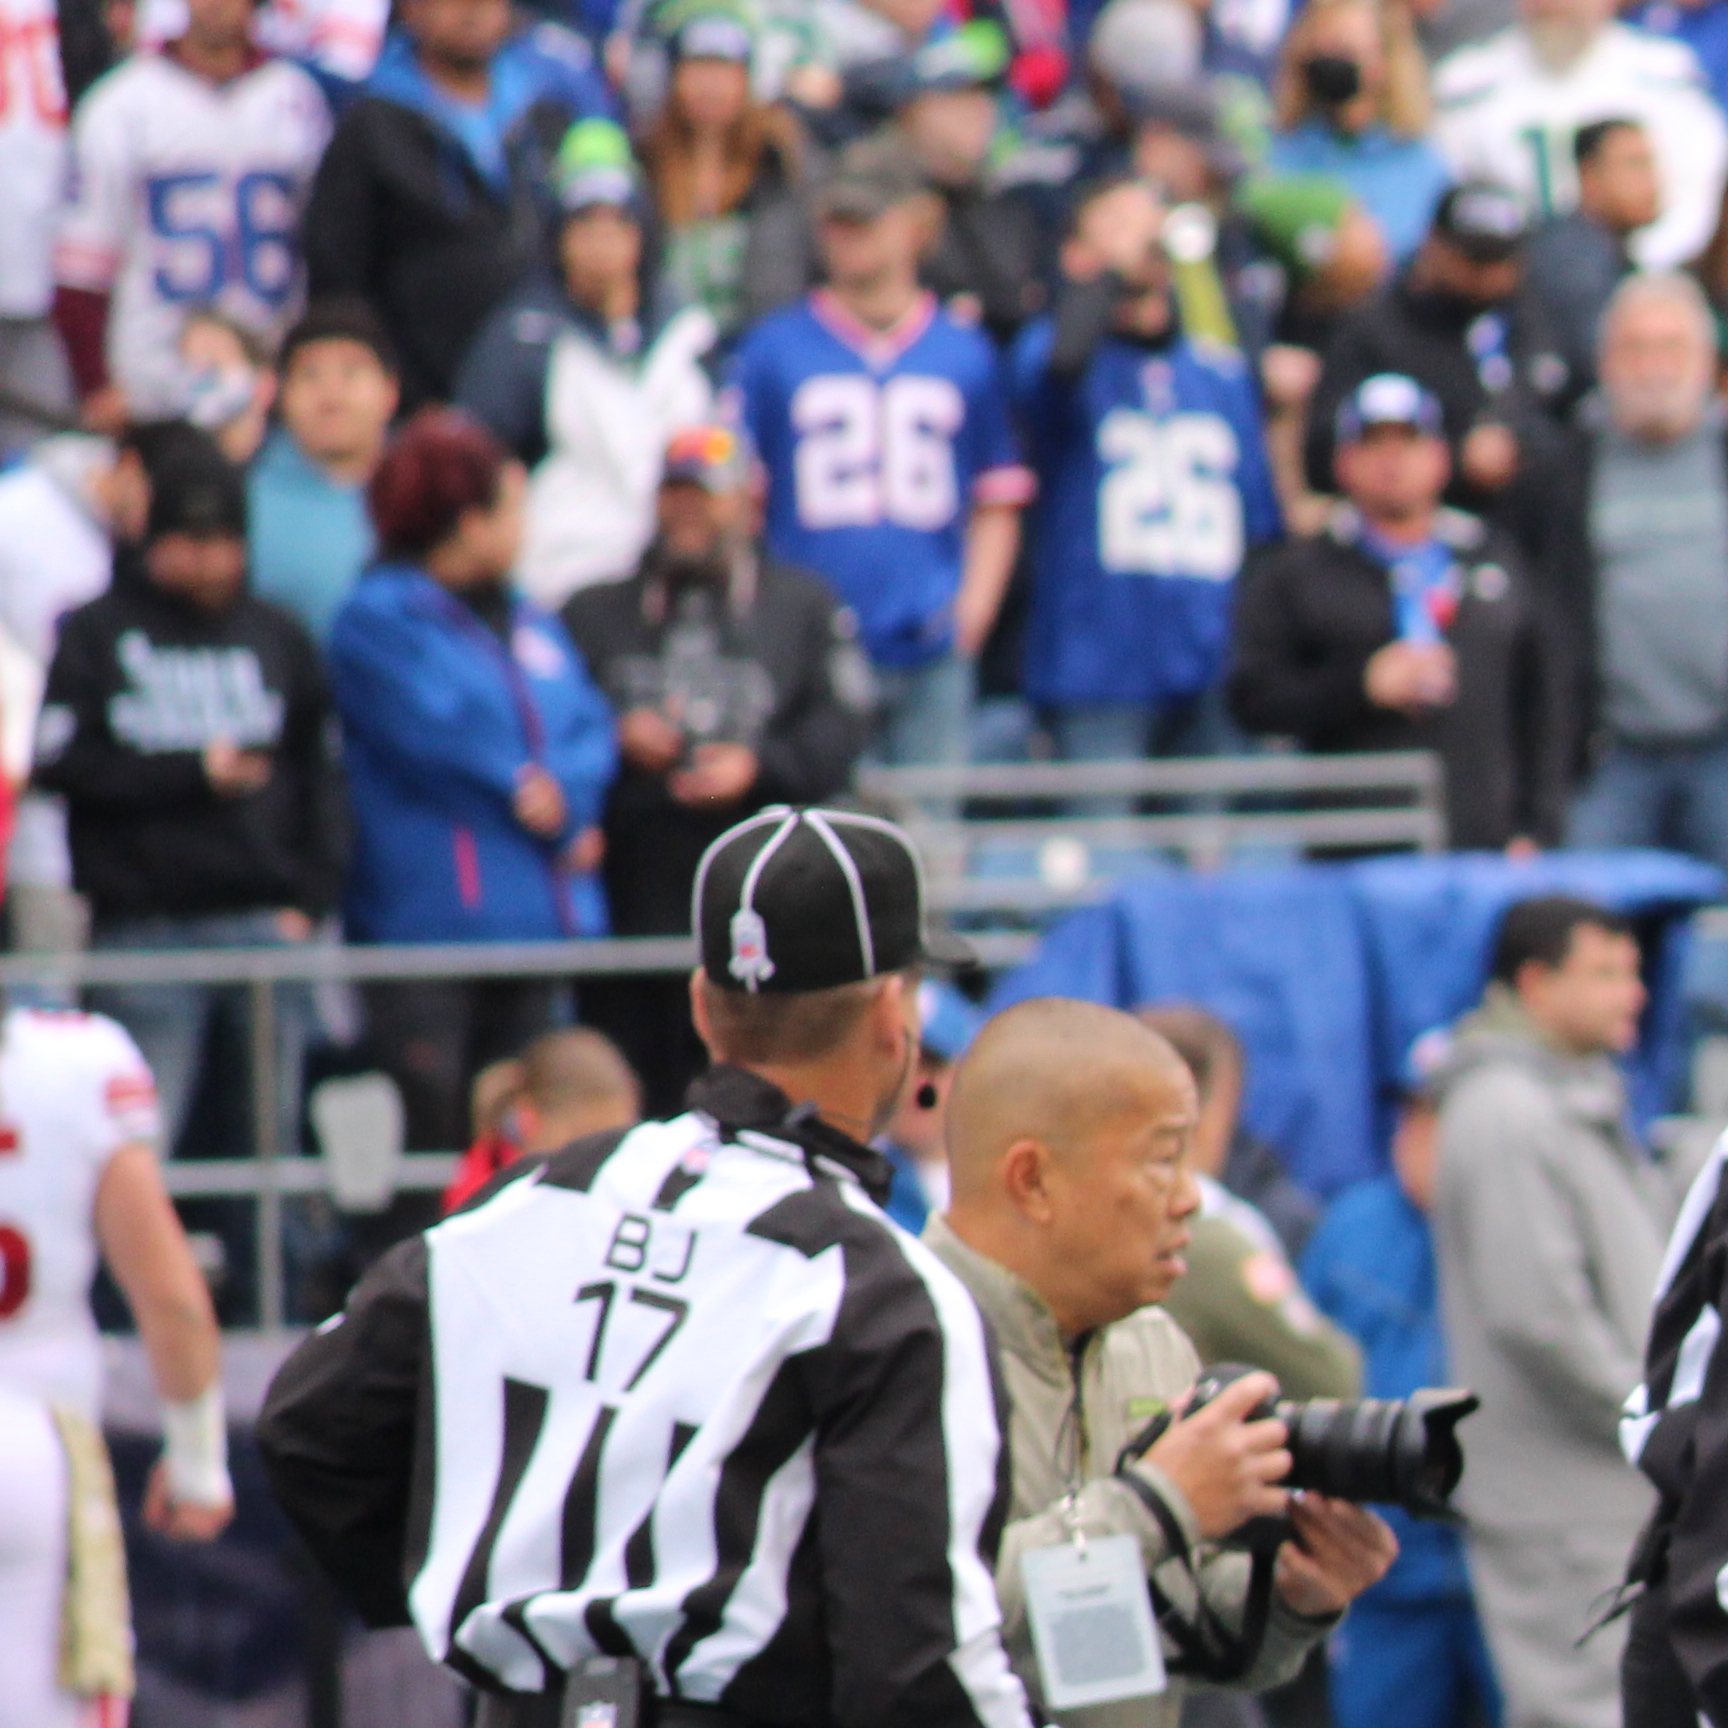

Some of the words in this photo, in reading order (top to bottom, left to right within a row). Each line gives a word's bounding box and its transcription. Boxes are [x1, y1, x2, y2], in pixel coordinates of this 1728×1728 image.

[147, 172, 304, 306] 56
[791, 372, 964, 533] 26
[1096, 410, 1243, 583] 26
[605, 1210, 698, 1284] BJ
[572, 1279, 690, 1393] 17
